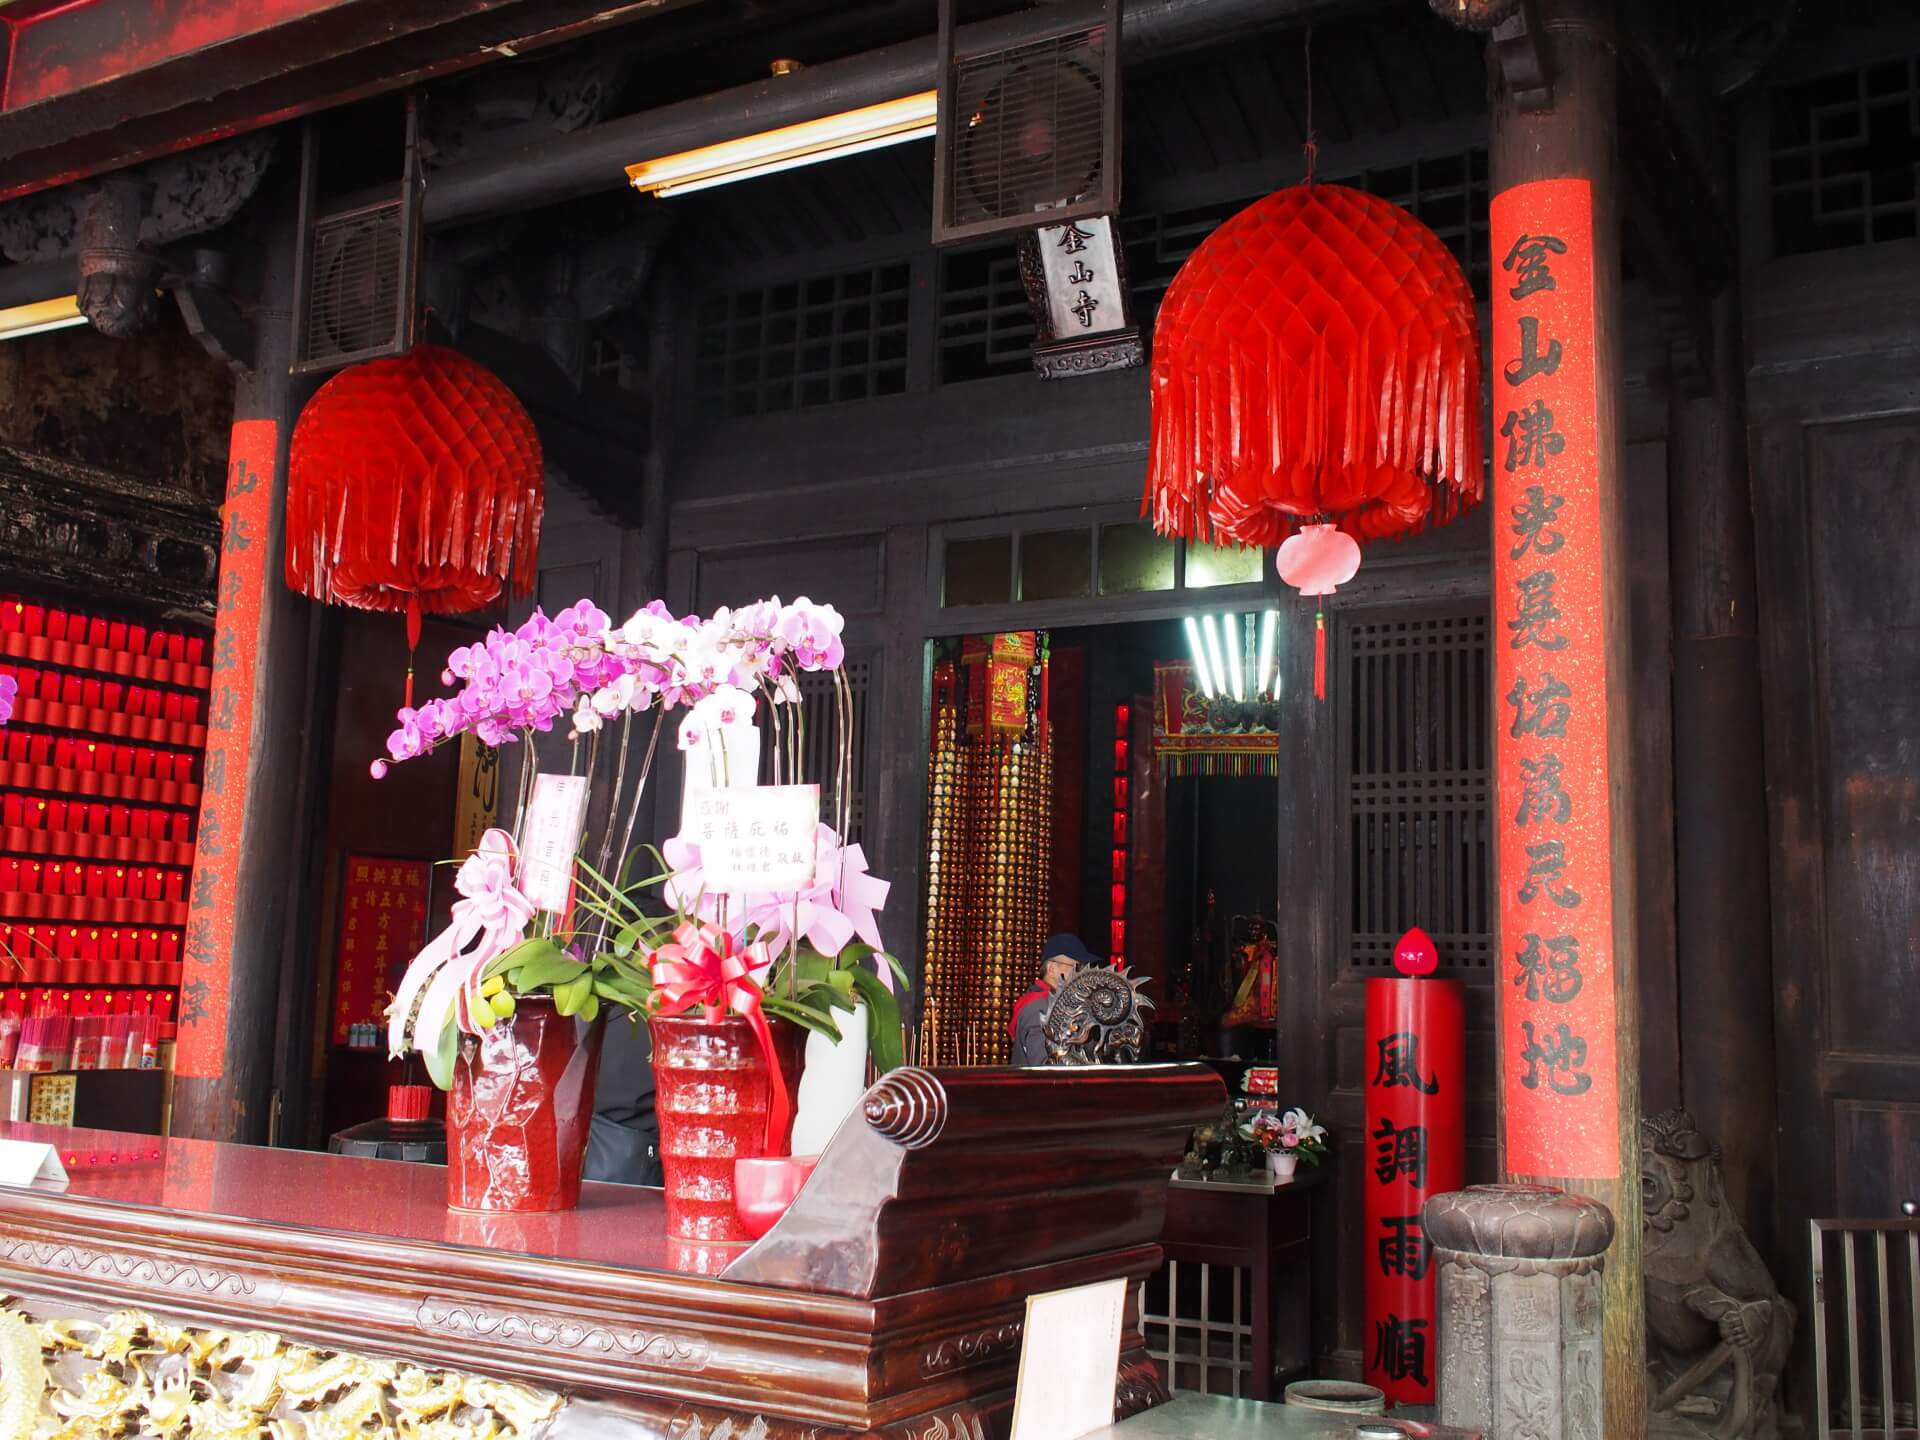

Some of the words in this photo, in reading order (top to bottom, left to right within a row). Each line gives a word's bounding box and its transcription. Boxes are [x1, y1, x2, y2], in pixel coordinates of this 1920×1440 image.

[1057, 222, 1099, 328] 金山寺
[1372, 1031, 1439, 1387] 風調雨順
